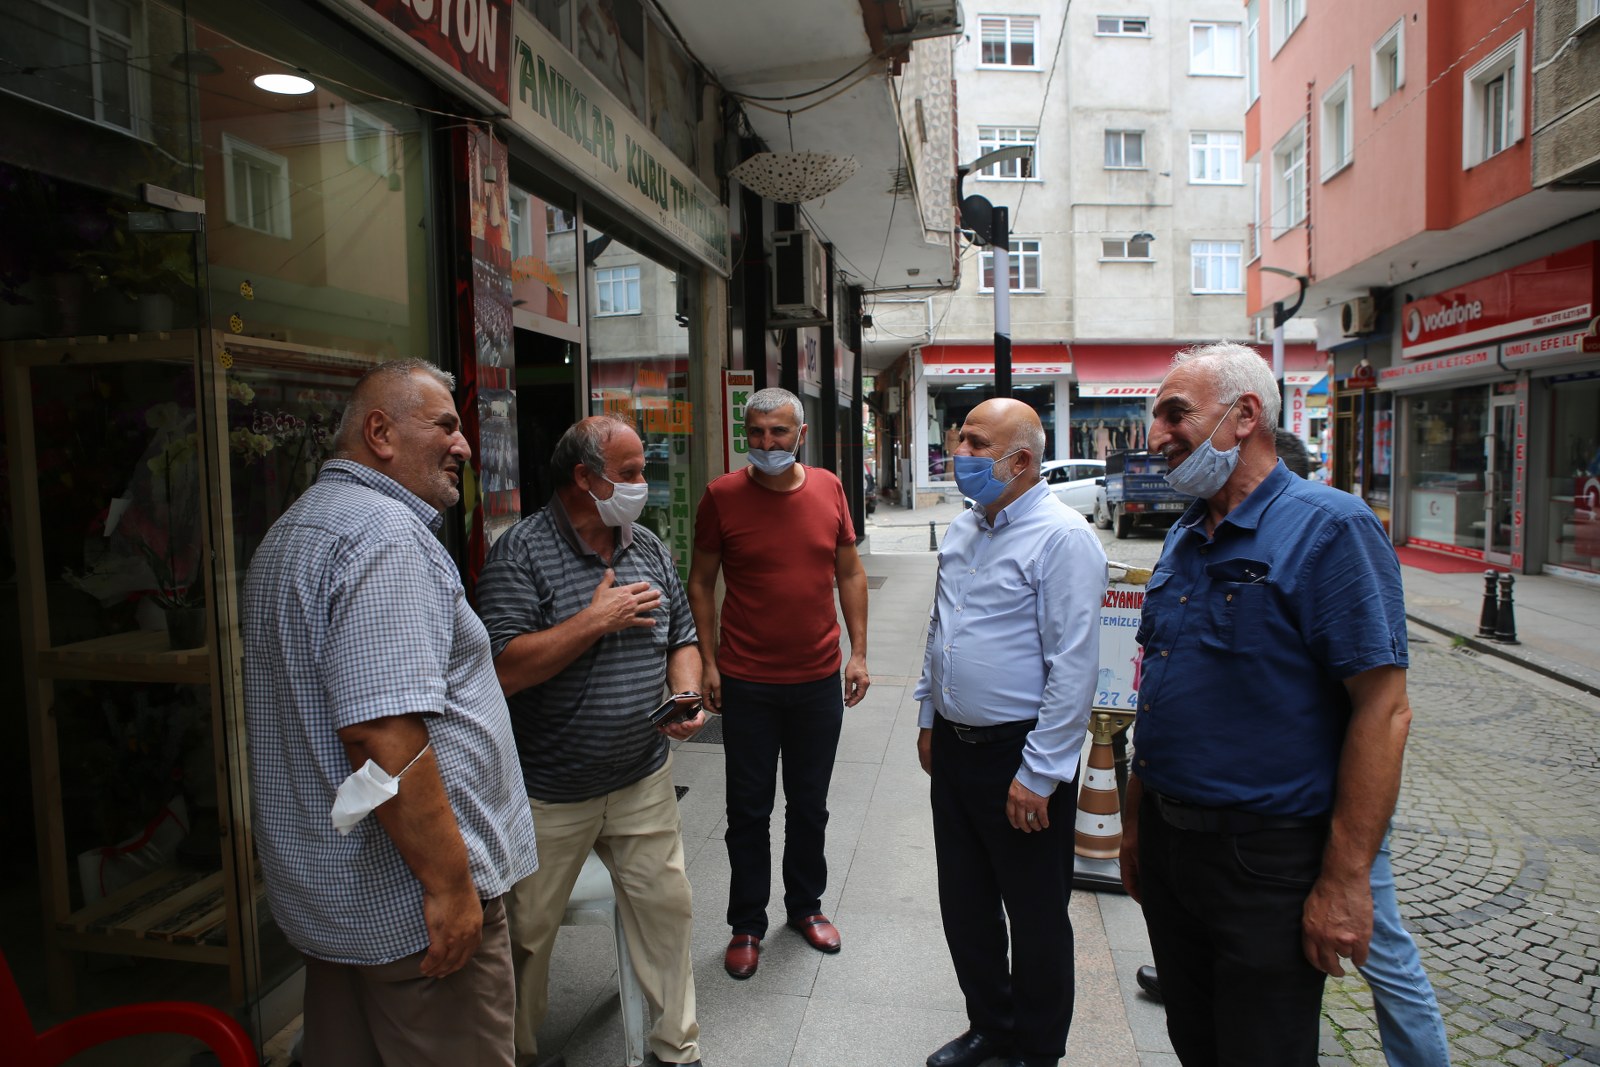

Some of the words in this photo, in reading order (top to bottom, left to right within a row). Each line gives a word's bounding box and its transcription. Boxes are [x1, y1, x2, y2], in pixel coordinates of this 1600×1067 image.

[626, 133, 669, 212] KURU
[1423, 300, 1482, 333] vodafone
[1504, 340, 1529, 356] UMUT
[1540, 336, 1559, 351] EFE
[1415, 360, 1433, 374] EFE
[1098, 691, 1120, 706] 27
